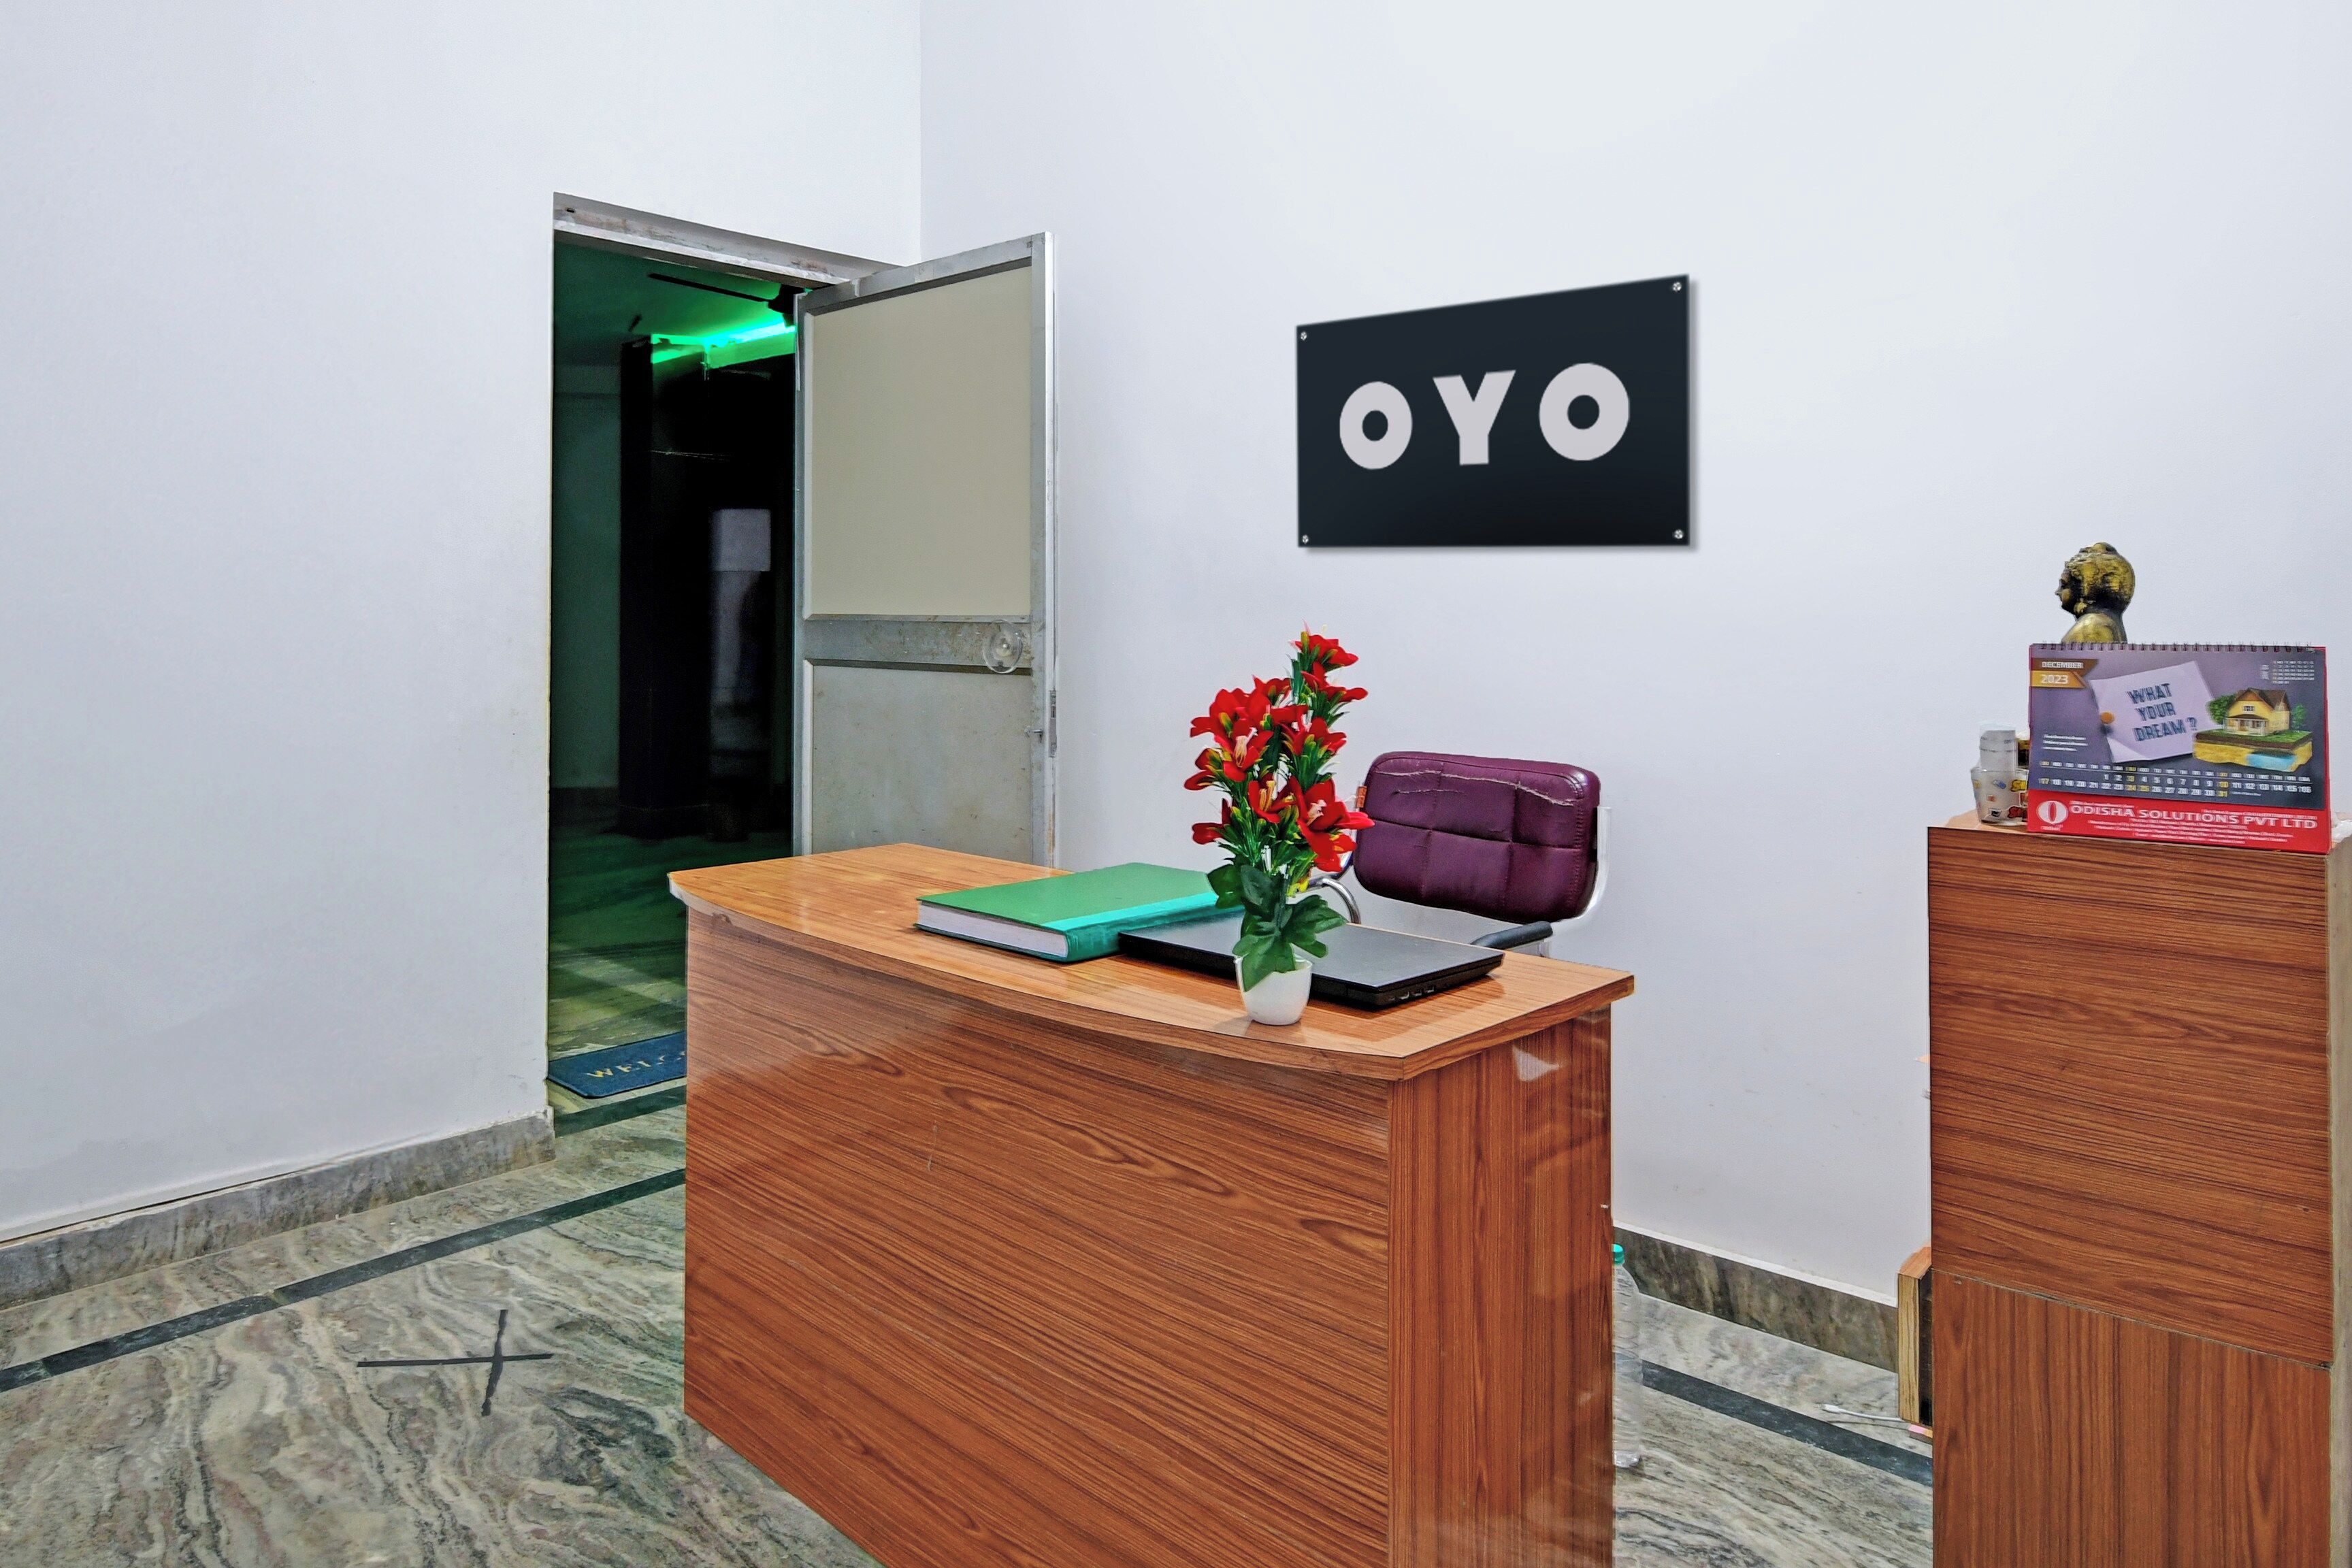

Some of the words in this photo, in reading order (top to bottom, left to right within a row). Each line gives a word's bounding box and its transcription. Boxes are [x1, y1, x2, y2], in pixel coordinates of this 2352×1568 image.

[1339, 363, 1630, 470] OYO
[2040, 674, 2068, 685] 2023
[2126, 683, 2172, 704] WHAT
[2135, 702, 2177, 721] YOUR
[2070, 804, 2135, 817] ODISHA
[2138, 808, 2239, 824] SOLUTIONS
[2244, 816, 2279, 827] PVT
[2281, 818, 2318, 829] LTD
